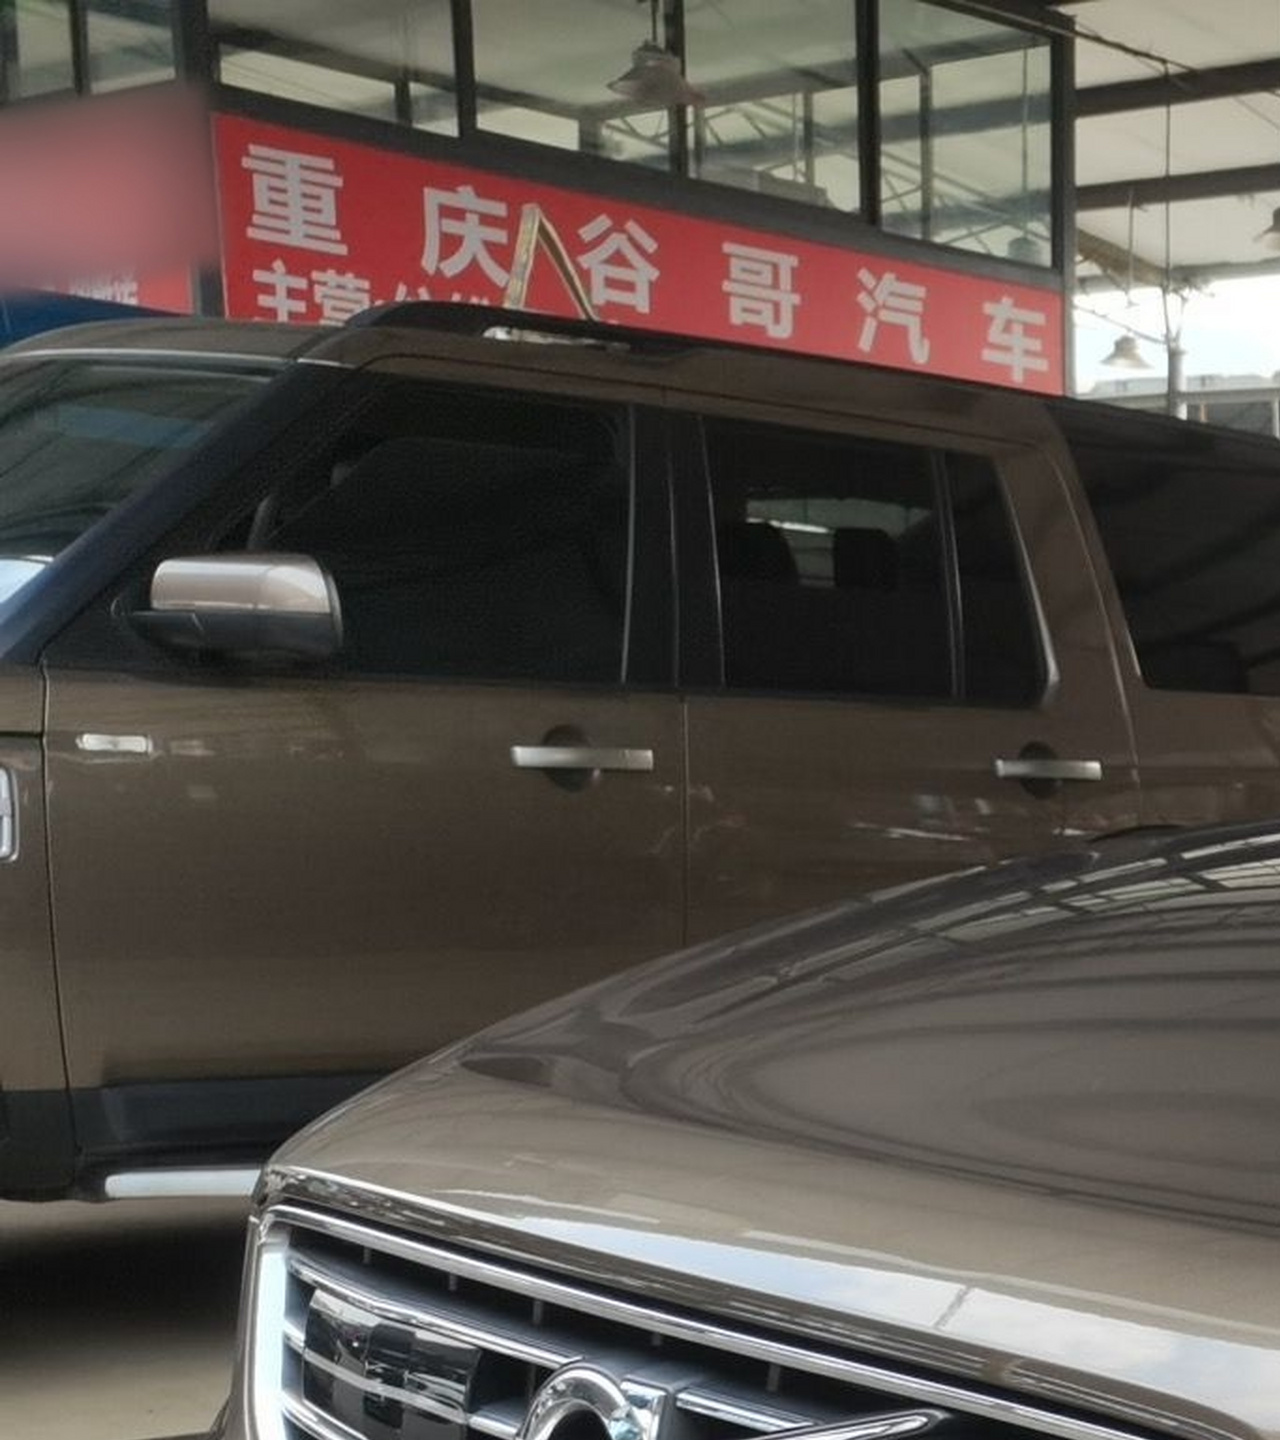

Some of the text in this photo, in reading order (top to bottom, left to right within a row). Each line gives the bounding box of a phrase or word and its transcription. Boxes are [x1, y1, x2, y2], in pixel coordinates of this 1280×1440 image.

[241, 143, 1049, 384] 重庆谷哥汽车
